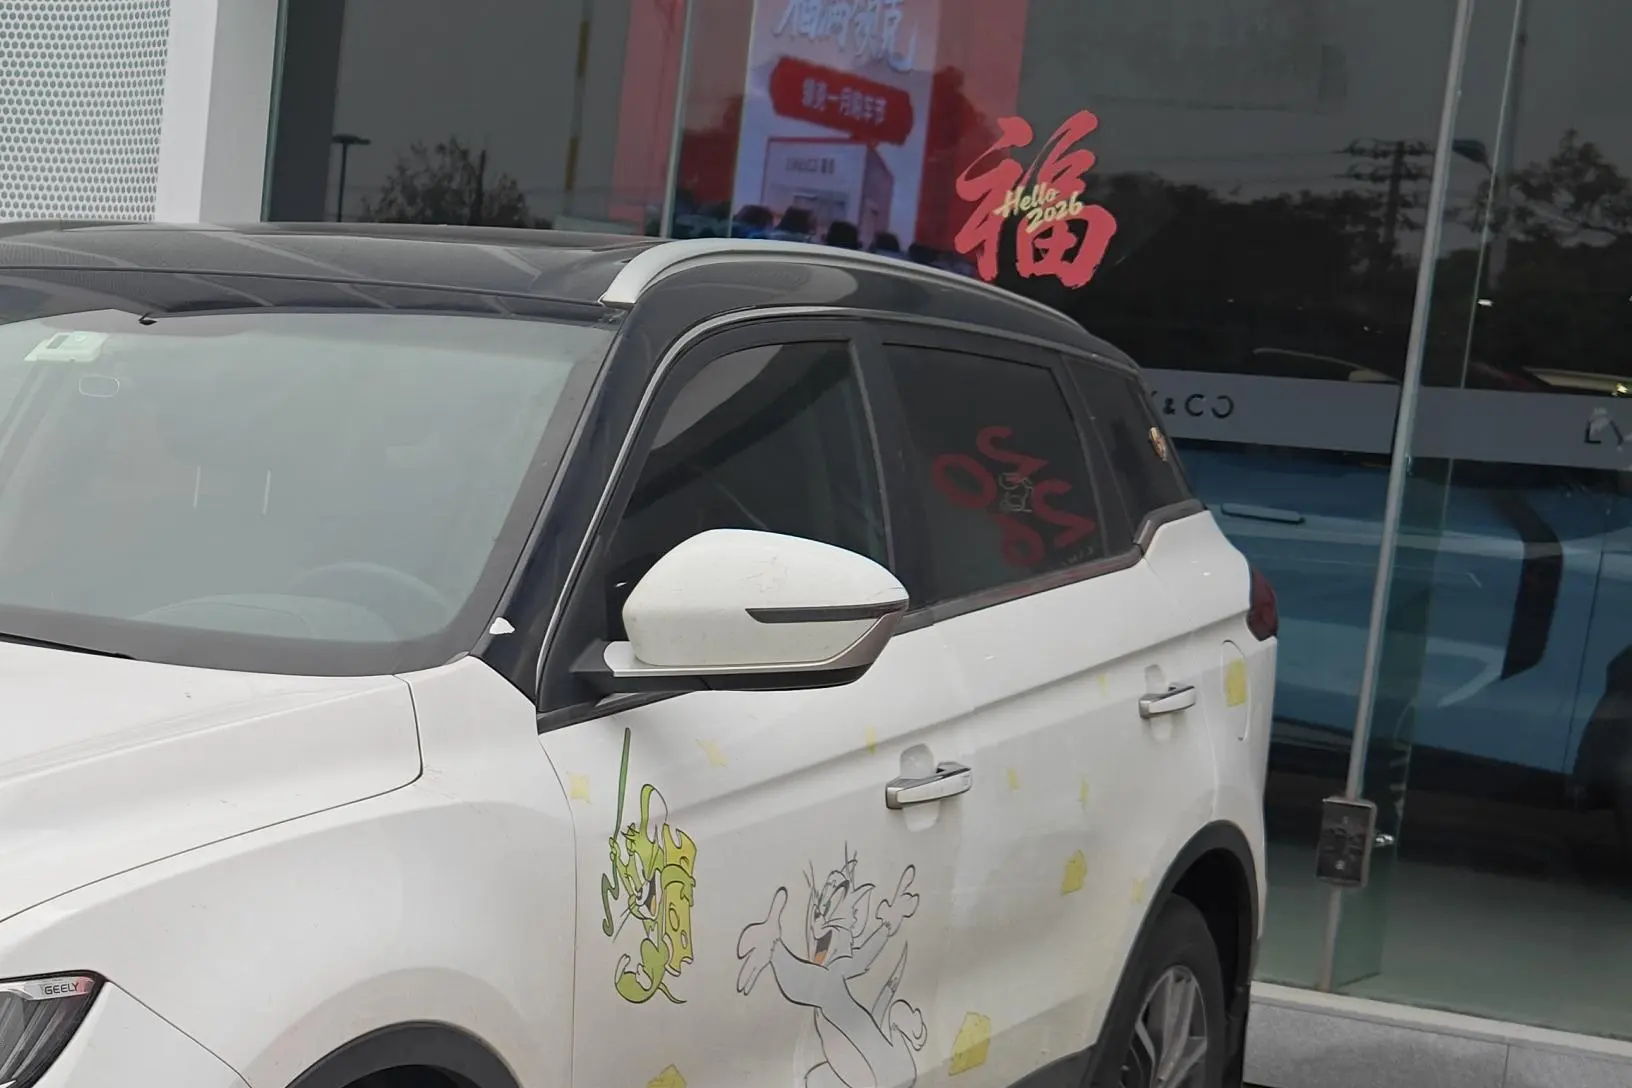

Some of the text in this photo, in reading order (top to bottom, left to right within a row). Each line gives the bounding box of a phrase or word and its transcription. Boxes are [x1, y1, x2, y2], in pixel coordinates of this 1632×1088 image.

[954, 110, 1117, 289] 福
[992, 182, 1061, 219] Hello
[1024, 191, 1084, 234] 2026
[43, 981, 80, 996] GEELY
